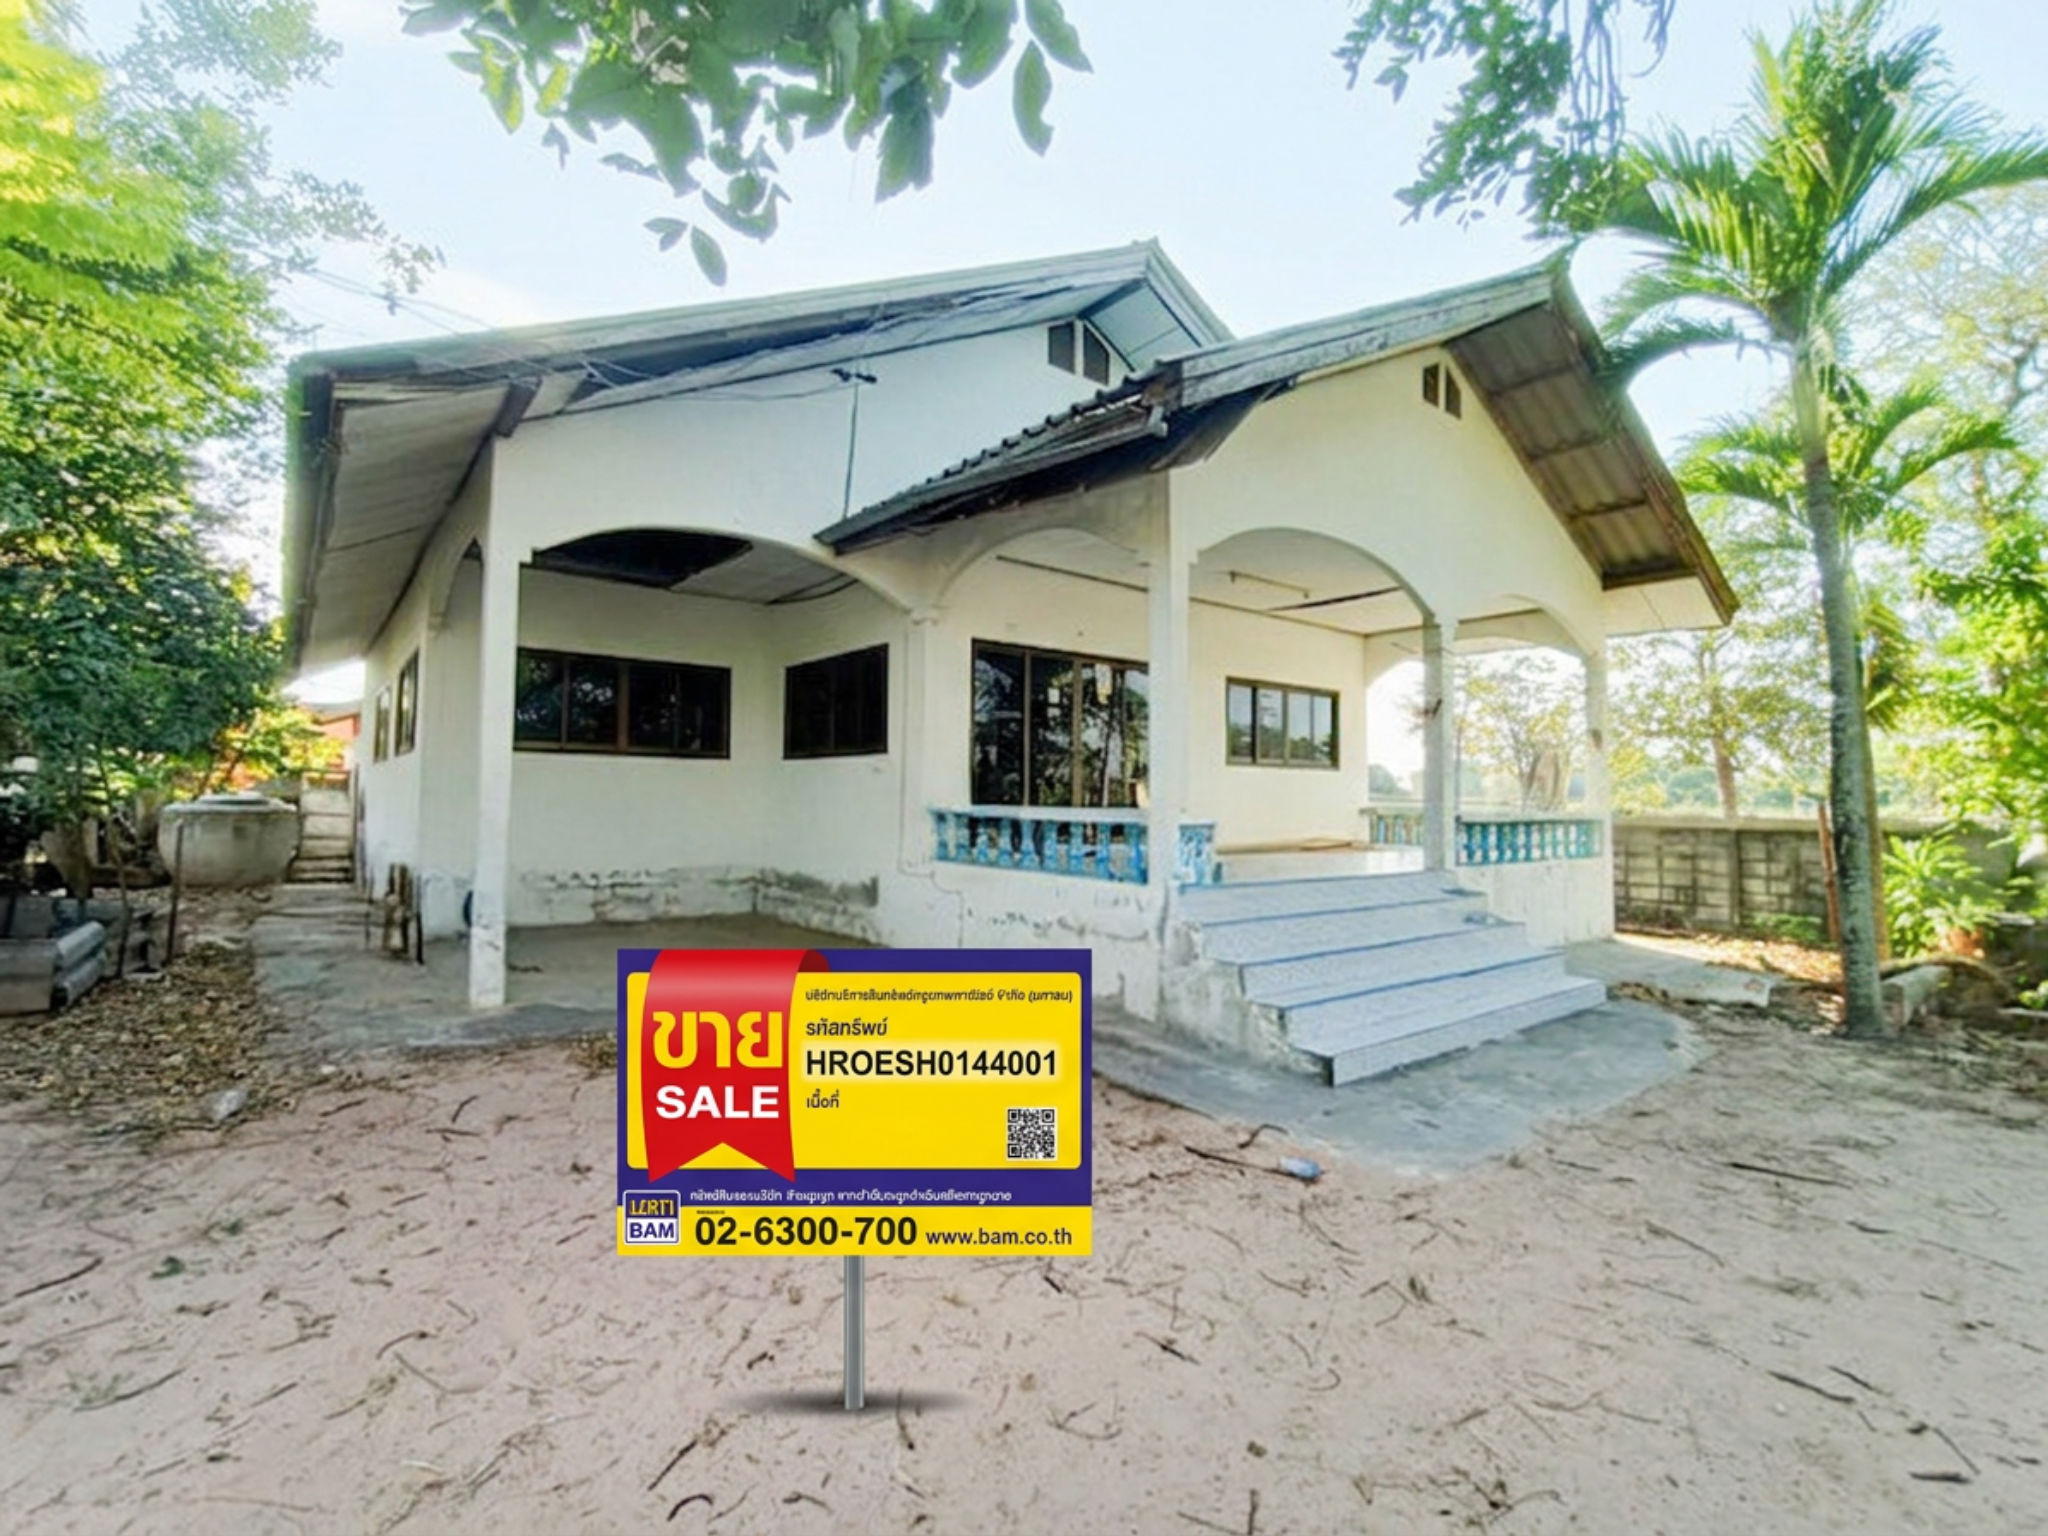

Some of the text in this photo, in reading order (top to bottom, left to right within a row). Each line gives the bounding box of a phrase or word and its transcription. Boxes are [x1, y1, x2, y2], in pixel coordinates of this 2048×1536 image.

[653, 1011, 783, 1069] ขาย
[806, 1049, 1056, 1076] HROESH0144001
[656, 1085, 779, 1119] SALE
[630, 1222, 675, 1239] BAM
[695, 1216, 1073, 1246] 02-6300-700 www.bam.co.th
